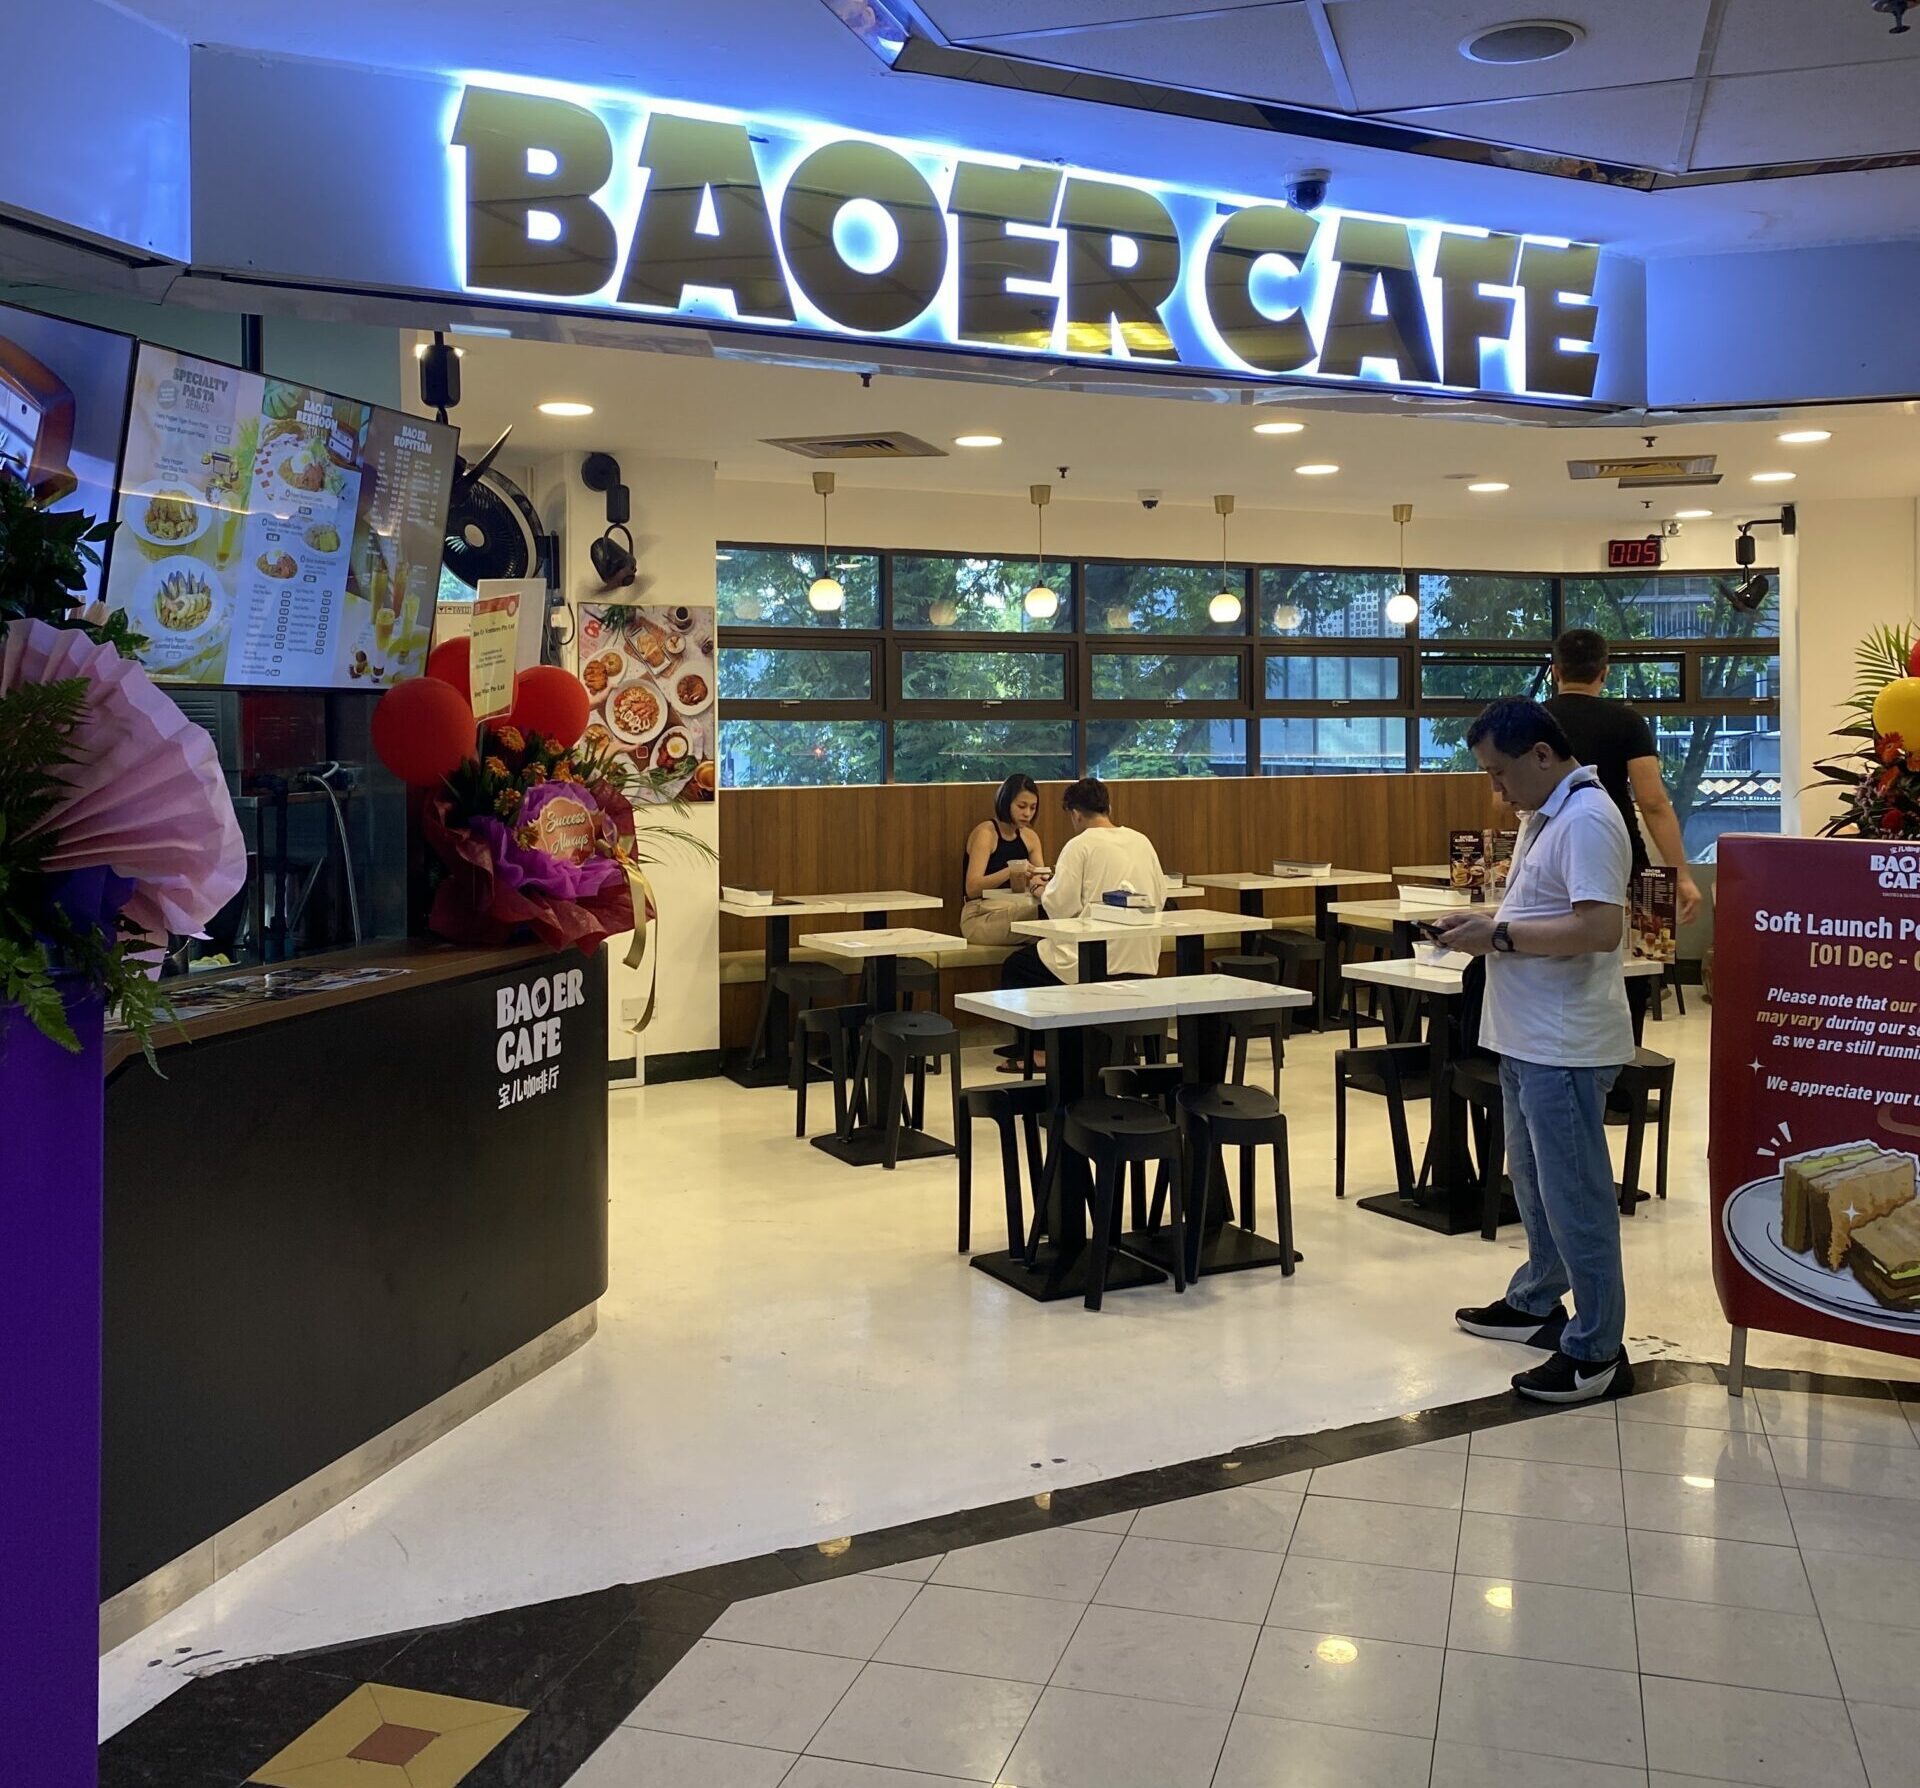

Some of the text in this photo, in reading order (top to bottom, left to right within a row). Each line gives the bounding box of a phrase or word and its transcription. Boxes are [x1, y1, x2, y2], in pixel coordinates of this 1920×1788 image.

[1204, 204, 1600, 398] CAFE
[173, 368, 228, 392] SPECIALTY
[182, 384, 215, 403] PASTA
[394, 435, 432, 454] KOPITIAM
[1610, 542, 1657, 564] 005
[545, 810, 587, 833] Success
[551, 832, 589, 854] Always
[1754, 909, 1801, 934] Soft
[1806, 913, 1893, 940] Launch
[1810, 941, 1842, 968] [01
[1848, 945, 1894, 970] Dec
[1767, 987, 1918, 1014] Please note that our
[1756, 1010, 1788, 1027] may
[1790, 1014, 1824, 1031] vary
[1825, 1015, 1876, 1036] during
[1878, 1022, 1906, 1036] our
[496, 1016, 562, 1074] CAFE
[1772, 1034, 1920, 1060] as we are still runni
[498, 1064, 560, 1110] 宝儿咖啡厅
[1766, 1075, 1788, 1091] We
[1790, 1080, 1872, 1100] appreciate
[1874, 1090, 1912, 1106] your
